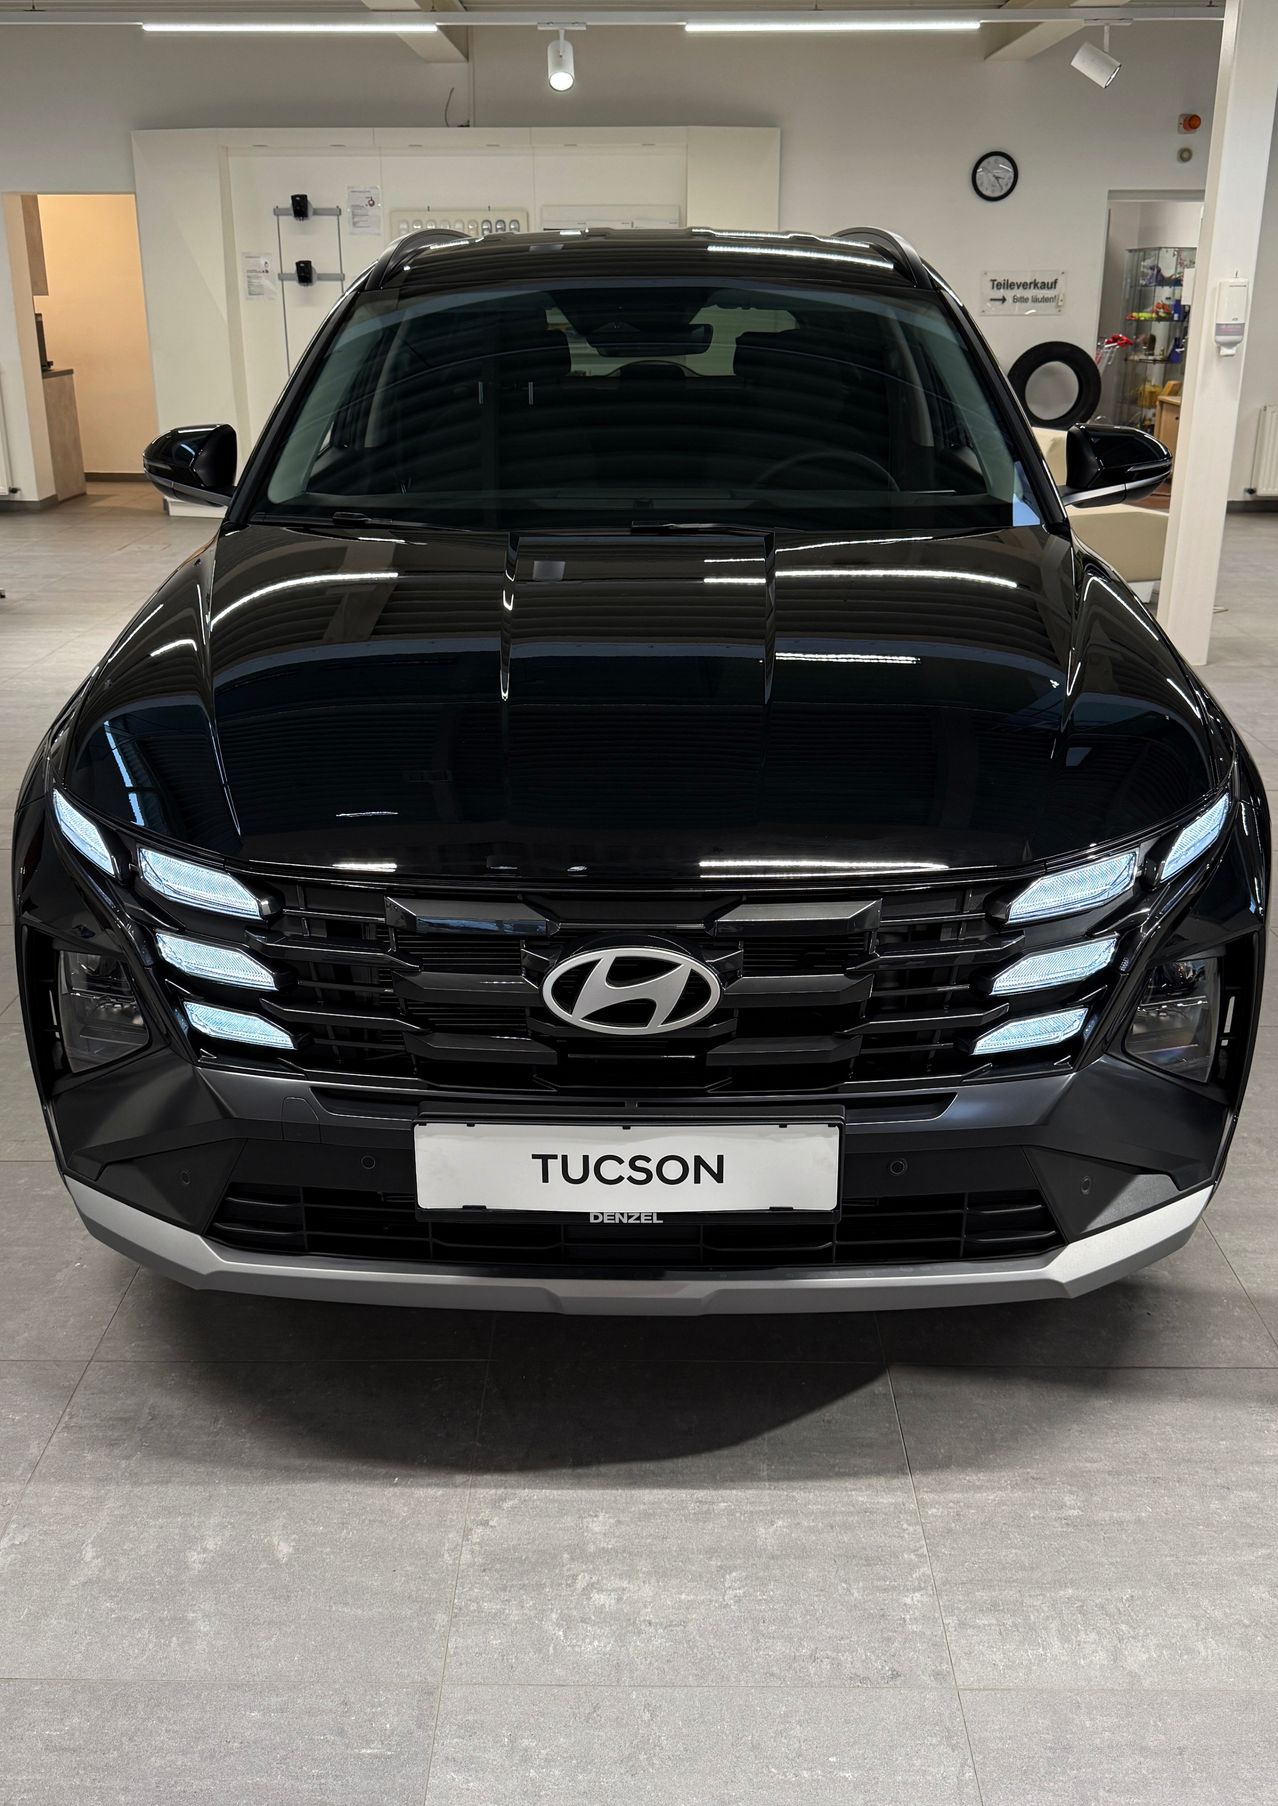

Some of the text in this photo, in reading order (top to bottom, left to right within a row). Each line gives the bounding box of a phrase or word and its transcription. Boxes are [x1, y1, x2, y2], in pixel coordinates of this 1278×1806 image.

[990, 278, 1058, 290] Teileverkauf
[1012, 294, 1057, 304] Bitte läuten!
[531, 1153, 725, 1186] TUCSON
[589, 1212, 664, 1224] DENZEL
